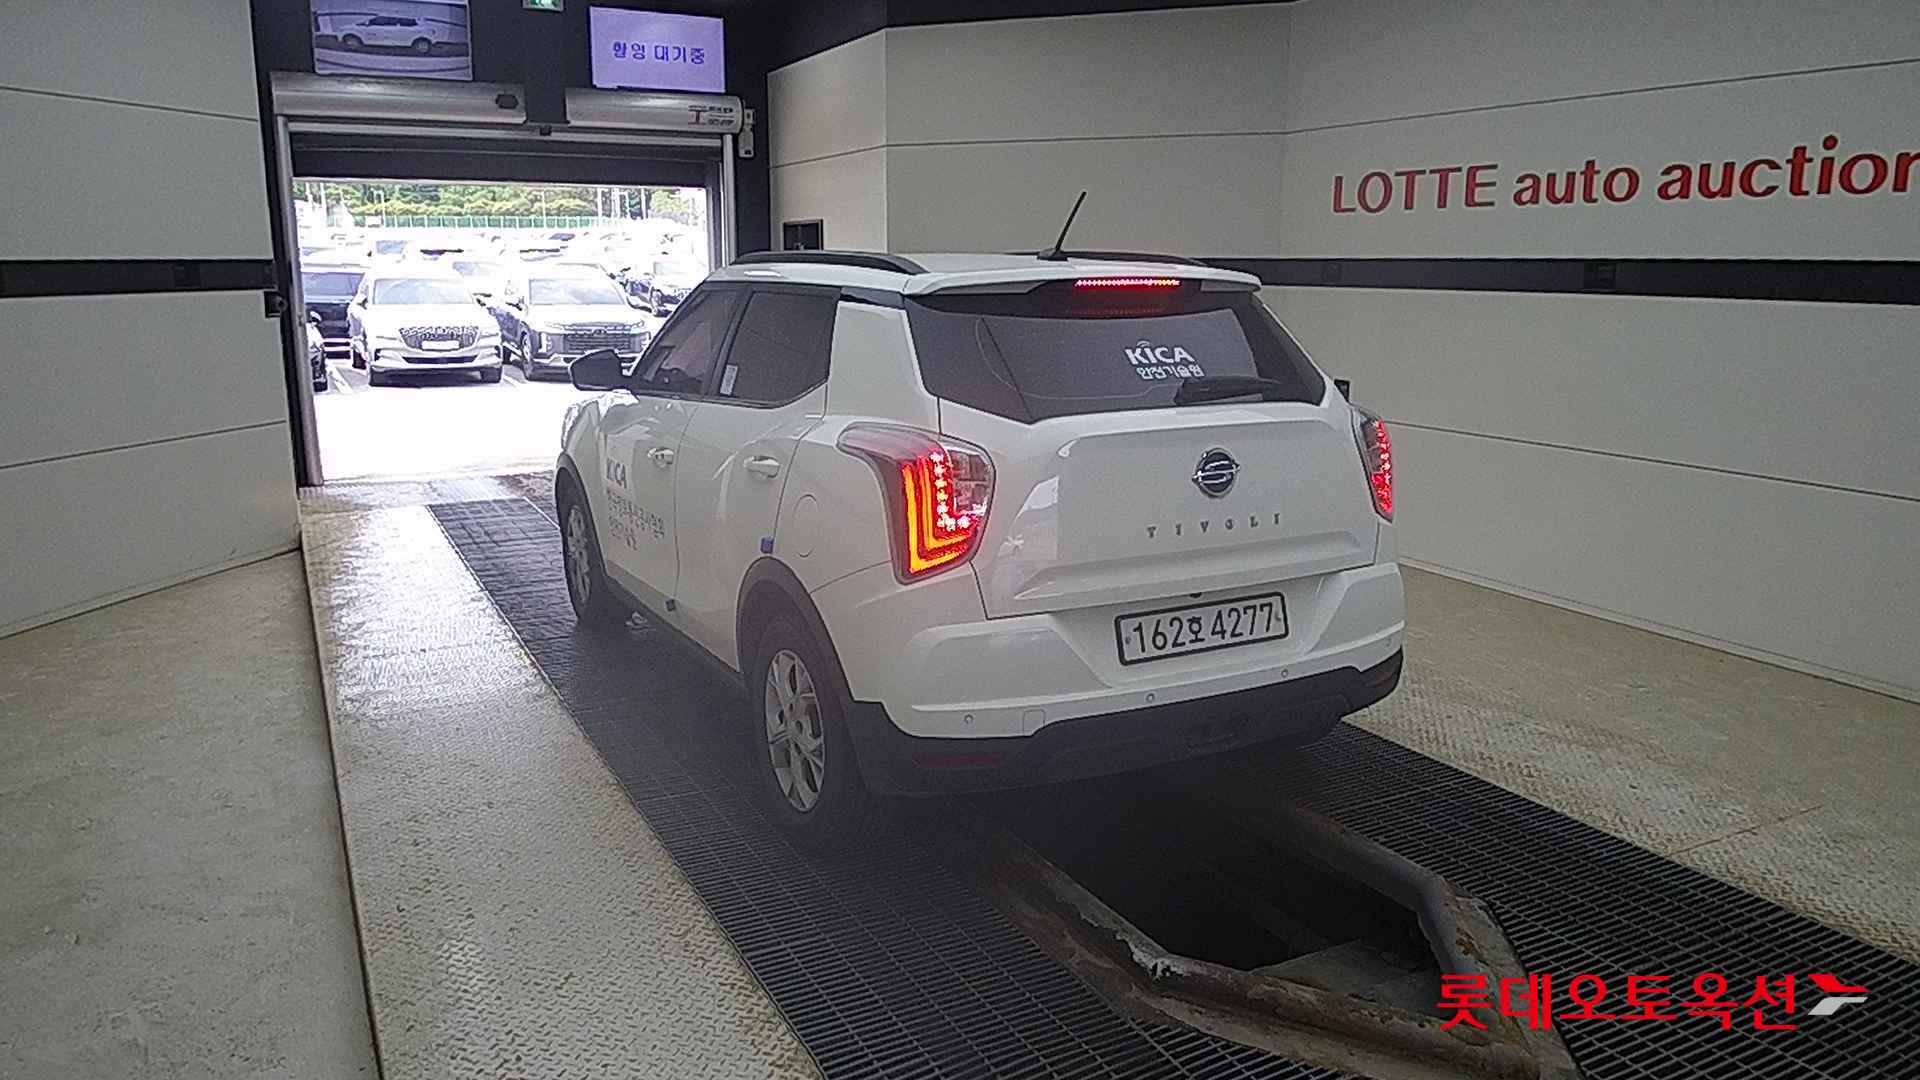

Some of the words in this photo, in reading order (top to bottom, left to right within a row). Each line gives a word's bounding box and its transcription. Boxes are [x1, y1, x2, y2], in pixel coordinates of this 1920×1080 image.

[654, 45, 705, 65] 대기중
[1332, 164, 1498, 213] LOTTE
[1513, 160, 1640, 206] auto
[1125, 346, 1196, 365] KICA
[1147, 512, 1281, 538] TIVOLI
[1132, 615, 1205, 653] 162호
[1210, 602, 1273, 640] 4277
